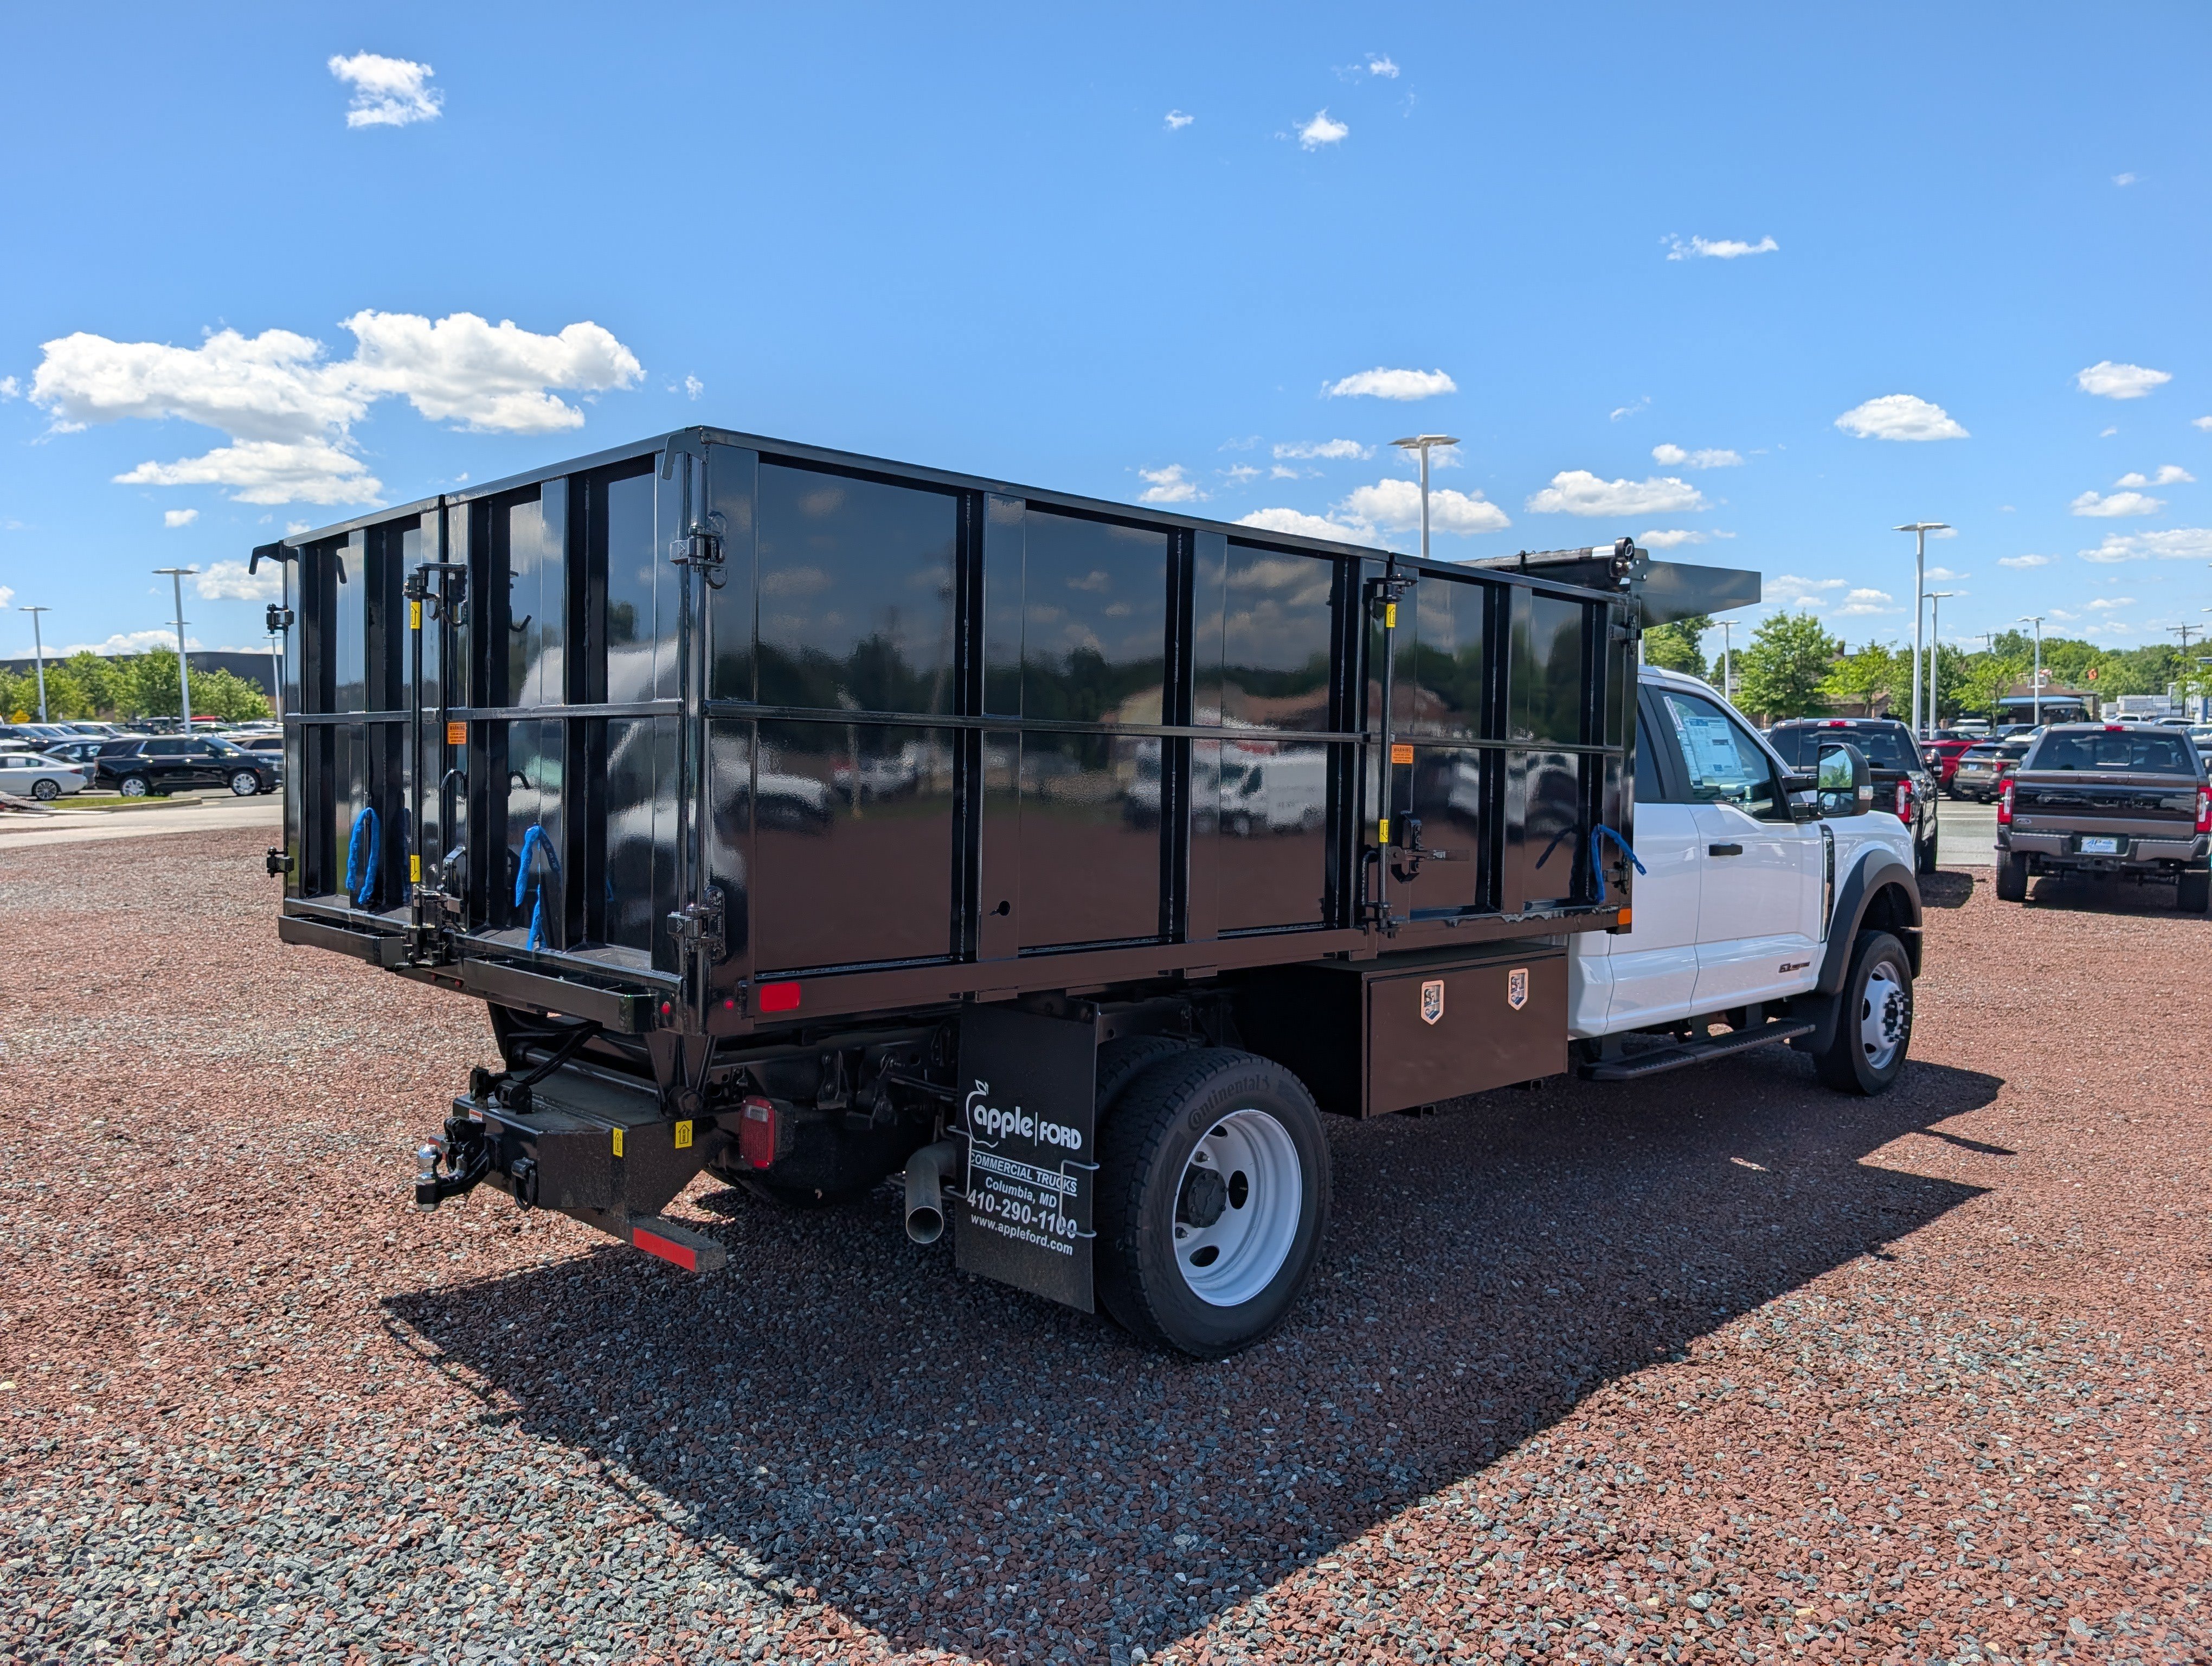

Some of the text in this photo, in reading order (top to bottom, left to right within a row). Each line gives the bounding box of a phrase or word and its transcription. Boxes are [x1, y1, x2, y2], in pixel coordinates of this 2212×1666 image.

[1188, 1074, 1261, 1131] Continental
[974, 1105, 1082, 1150] apple FORD
[967, 1189, 1077, 1239] 410-290-1100
[986, 1177, 1057, 1208] Columbia, MD
[971, 1214, 1073, 1255] www.appleford.com
